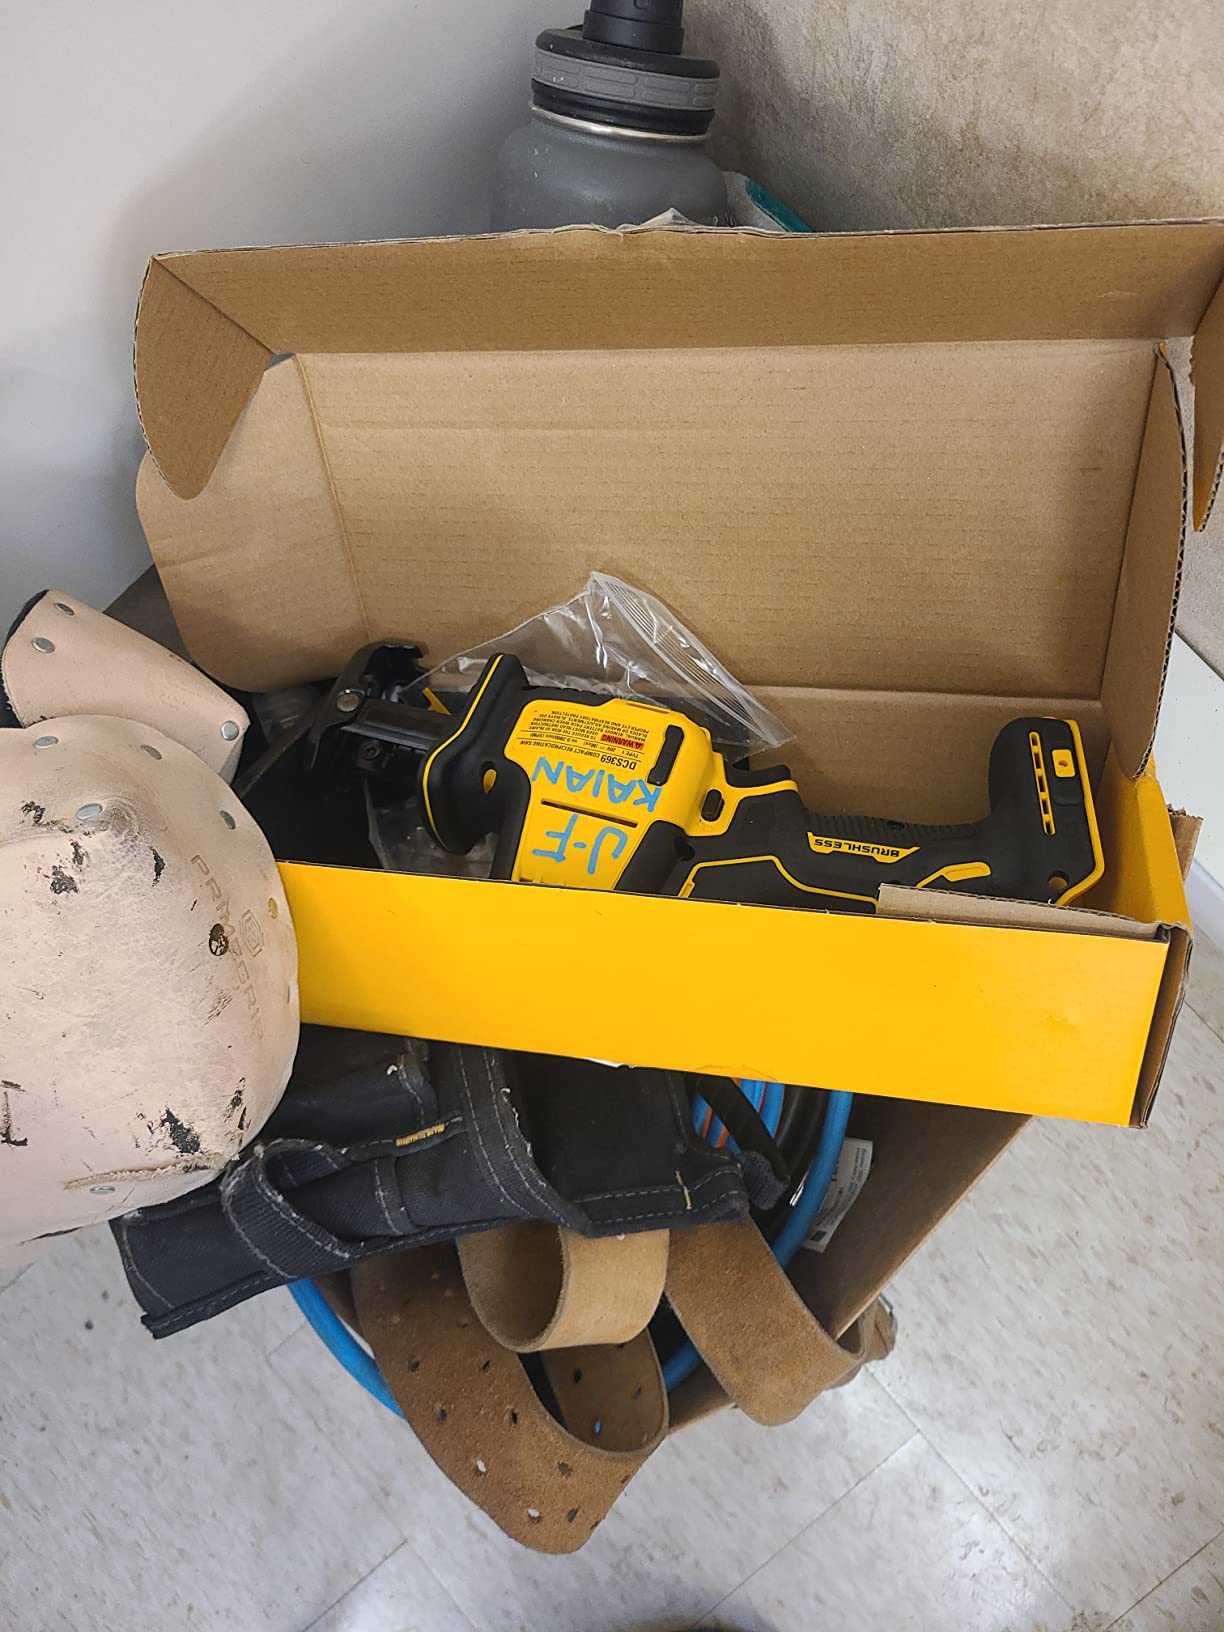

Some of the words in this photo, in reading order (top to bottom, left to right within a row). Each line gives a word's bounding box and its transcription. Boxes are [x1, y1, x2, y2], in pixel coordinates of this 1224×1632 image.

[533, 741, 573, 752] RECIPROCATING
[601, 735, 635, 748] WARNING
[574, 749, 600, 758] COMPACT
[601, 755, 637, 770] DCS369
[532, 756, 662, 813] KAIAN
[814, 839, 900, 858] BRUSHLESS
